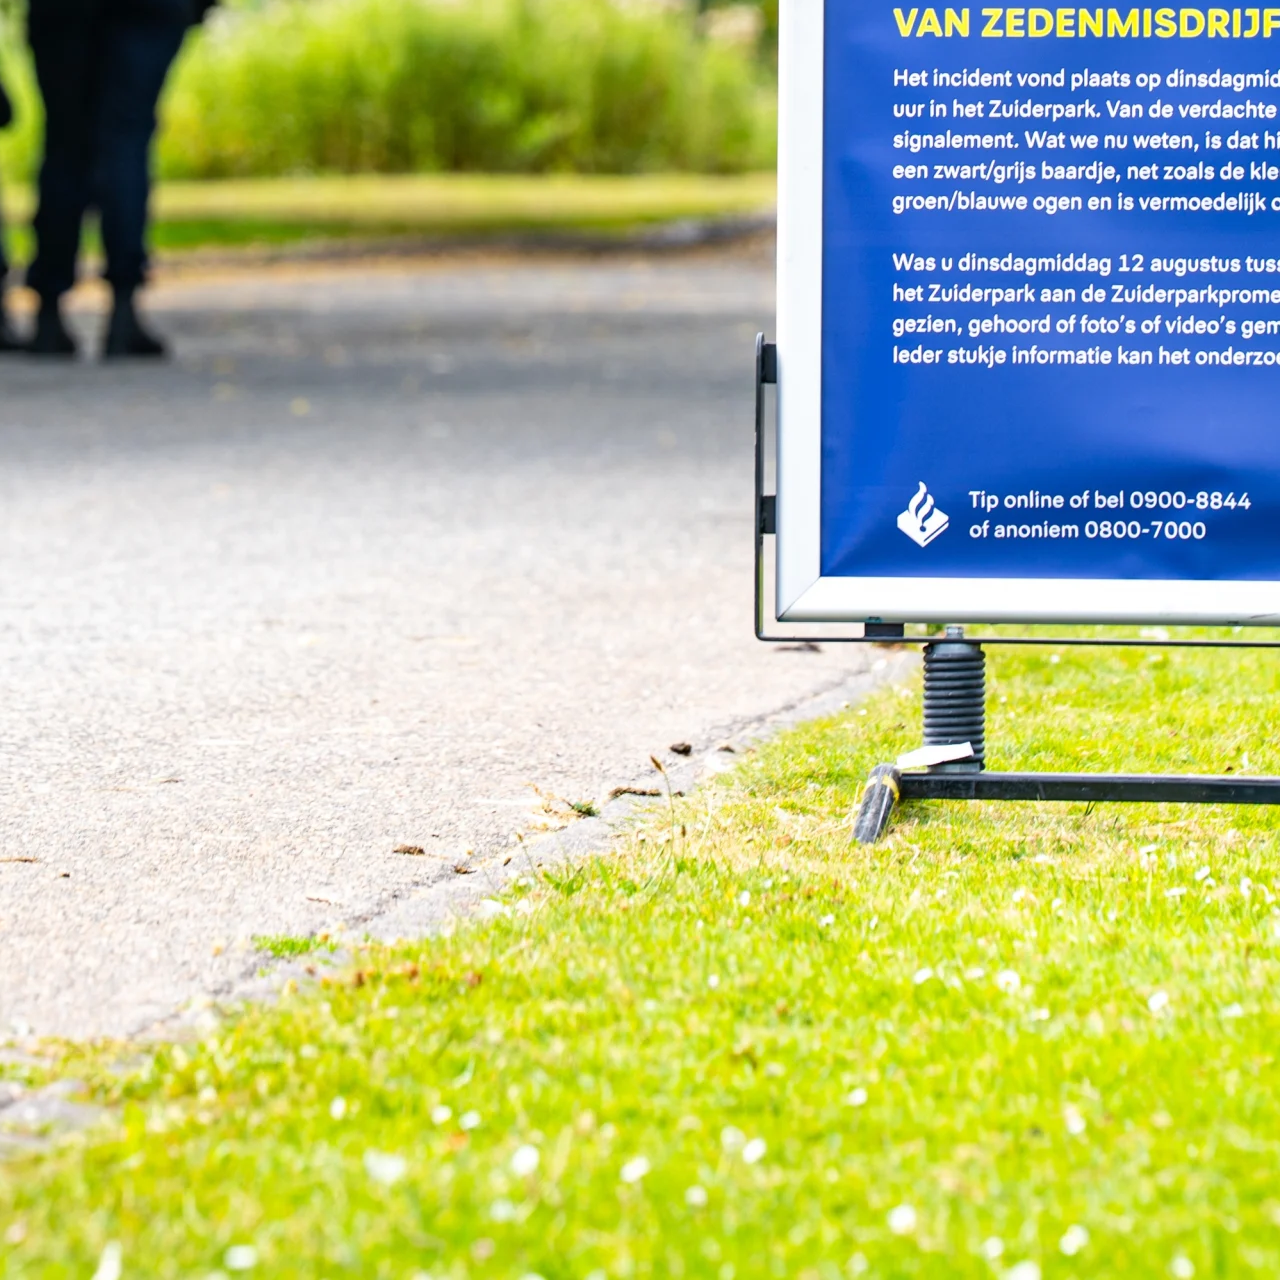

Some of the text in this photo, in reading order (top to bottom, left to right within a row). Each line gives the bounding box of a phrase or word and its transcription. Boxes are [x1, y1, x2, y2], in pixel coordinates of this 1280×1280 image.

[892, 7, 971, 38] VAN
[893, 68, 929, 87] Het
[932, 67, 1013, 88] incident
[1016, 67, 1065, 88] vond
[1070, 67, 1132, 92] plaats
[1135, 72, 1162, 93] op
[892, 103, 926, 118] uur
[929, 99, 948, 118] in
[952, 98, 985, 119] het
[988, 98, 1102, 123] Zuiderpark.
[1105, 99, 1144, 119] Van
[1148, 98, 1174, 119] de
[1177, 98, 1278, 120] verdachte
[892, 129, 1020, 154] signalement.
[1024, 130, 1067, 149] Wat
[1069, 134, 1099, 149] we
[1103, 134, 1128, 150] nu
[1132, 131, 1200, 153] weten,
[1205, 130, 1223, 150] is
[1226, 129, 1260, 150] dat
[892, 164, 929, 180] een
[933, 159, 1037, 185] zwart/grijs
[1041, 160, 1121, 185] baardje,
[1127, 163, 1160, 181] net
[1163, 160, 1216, 181] zoals
[1219, 160, 1246, 181] de
[891, 189, 1029, 215] groen/blauwe
[1032, 195, 1083, 216] ogen
[1087, 196, 1113, 211] en
[1117, 191, 1135, 211] is
[1138, 191, 1267, 216] vermoedelijk
[891, 252, 937, 272] Was
[941, 257, 953, 272] u
[957, 252, 1112, 277] dinsdagmiddag
[1118, 253, 1145, 273] 12
[1149, 255, 1242, 278] augustus
[892, 282, 925, 303] het
[927, 282, 1036, 307] Zuiderpark
[1039, 288, 1076, 303] aan
[1080, 283, 1107, 304] de
[891, 314, 963, 338] gezien,
[967, 313, 1051, 338] gehoord
[1055, 313, 1077, 334] of
[1140, 314, 1162, 335] of
[892, 344, 944, 365] Ieder
[946, 344, 1008, 369] stukje
[1011, 344, 1113, 365] informatie
[1117, 345, 1154, 366] kan
[1158, 345, 1191, 366] het
[967, 489, 1252, 513] Tip online of bel 0900-8844
[968, 519, 1207, 540] of anoniem 0800-7000
